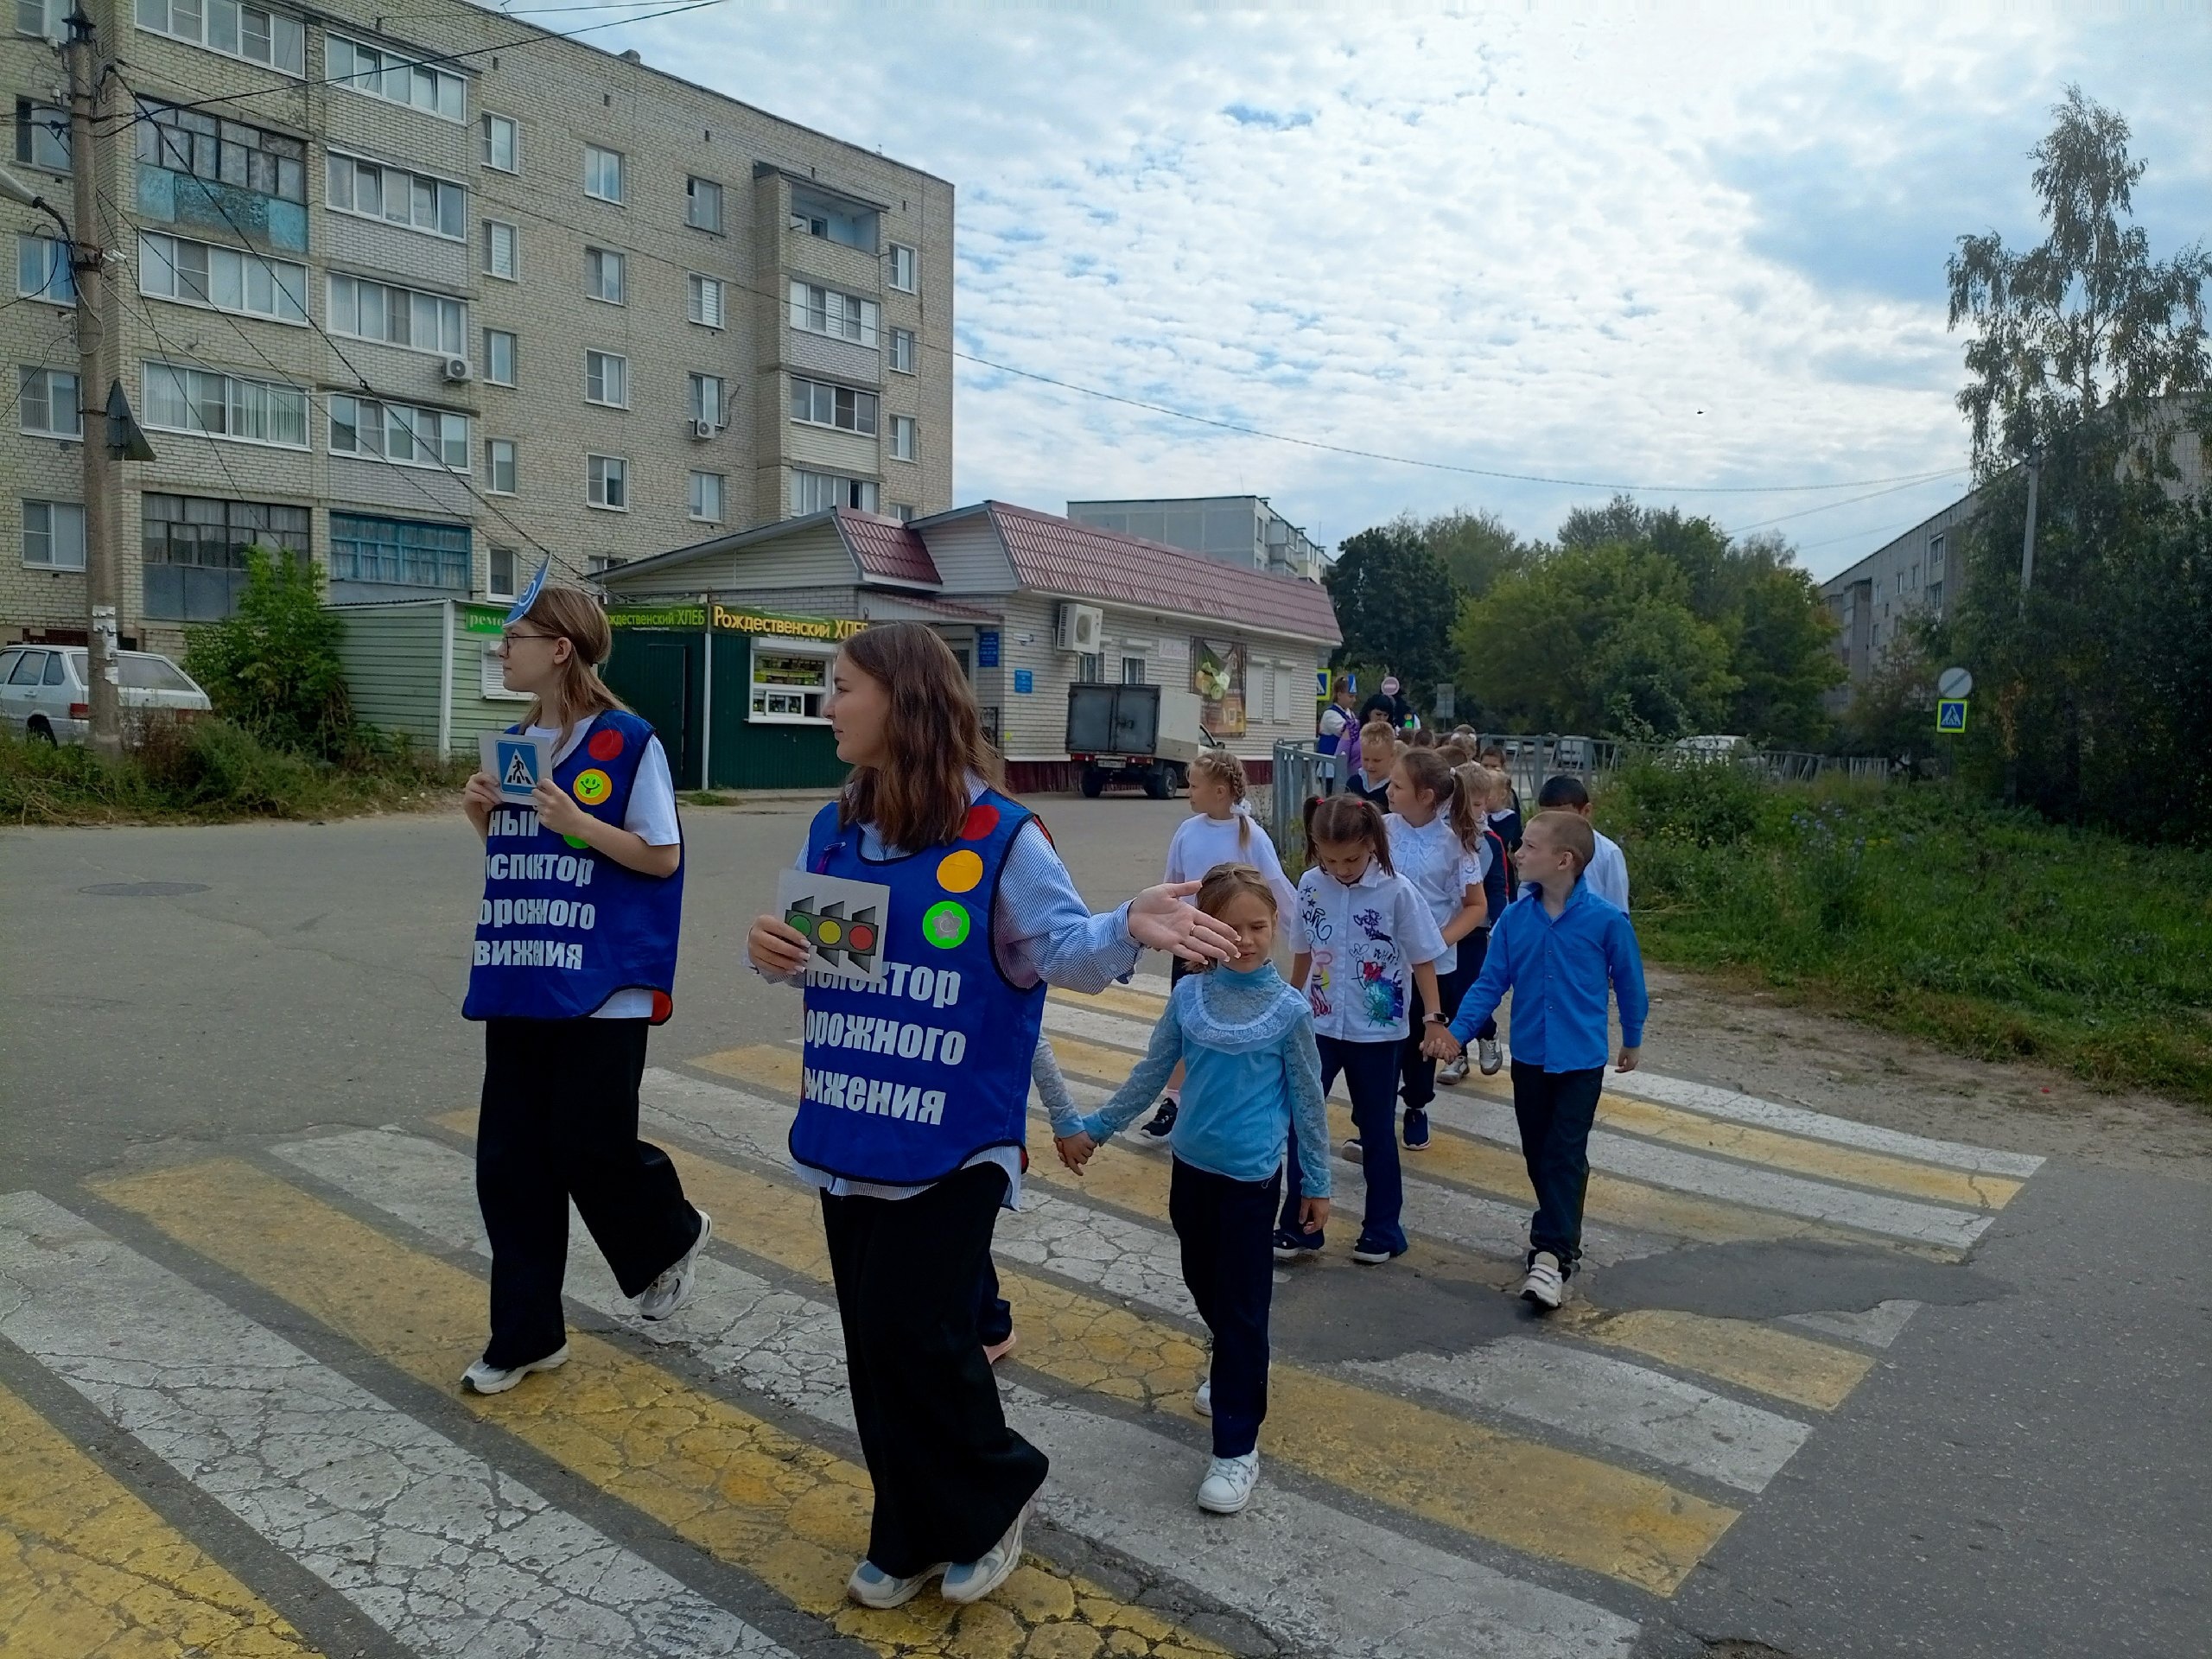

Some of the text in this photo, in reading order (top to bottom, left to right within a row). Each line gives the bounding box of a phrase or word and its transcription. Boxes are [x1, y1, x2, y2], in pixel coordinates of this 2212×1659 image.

[677, 609, 705, 626] ХЛЕБ
[714, 606, 830, 639] Рождественский
[806, 1009, 966, 1065] орожного
